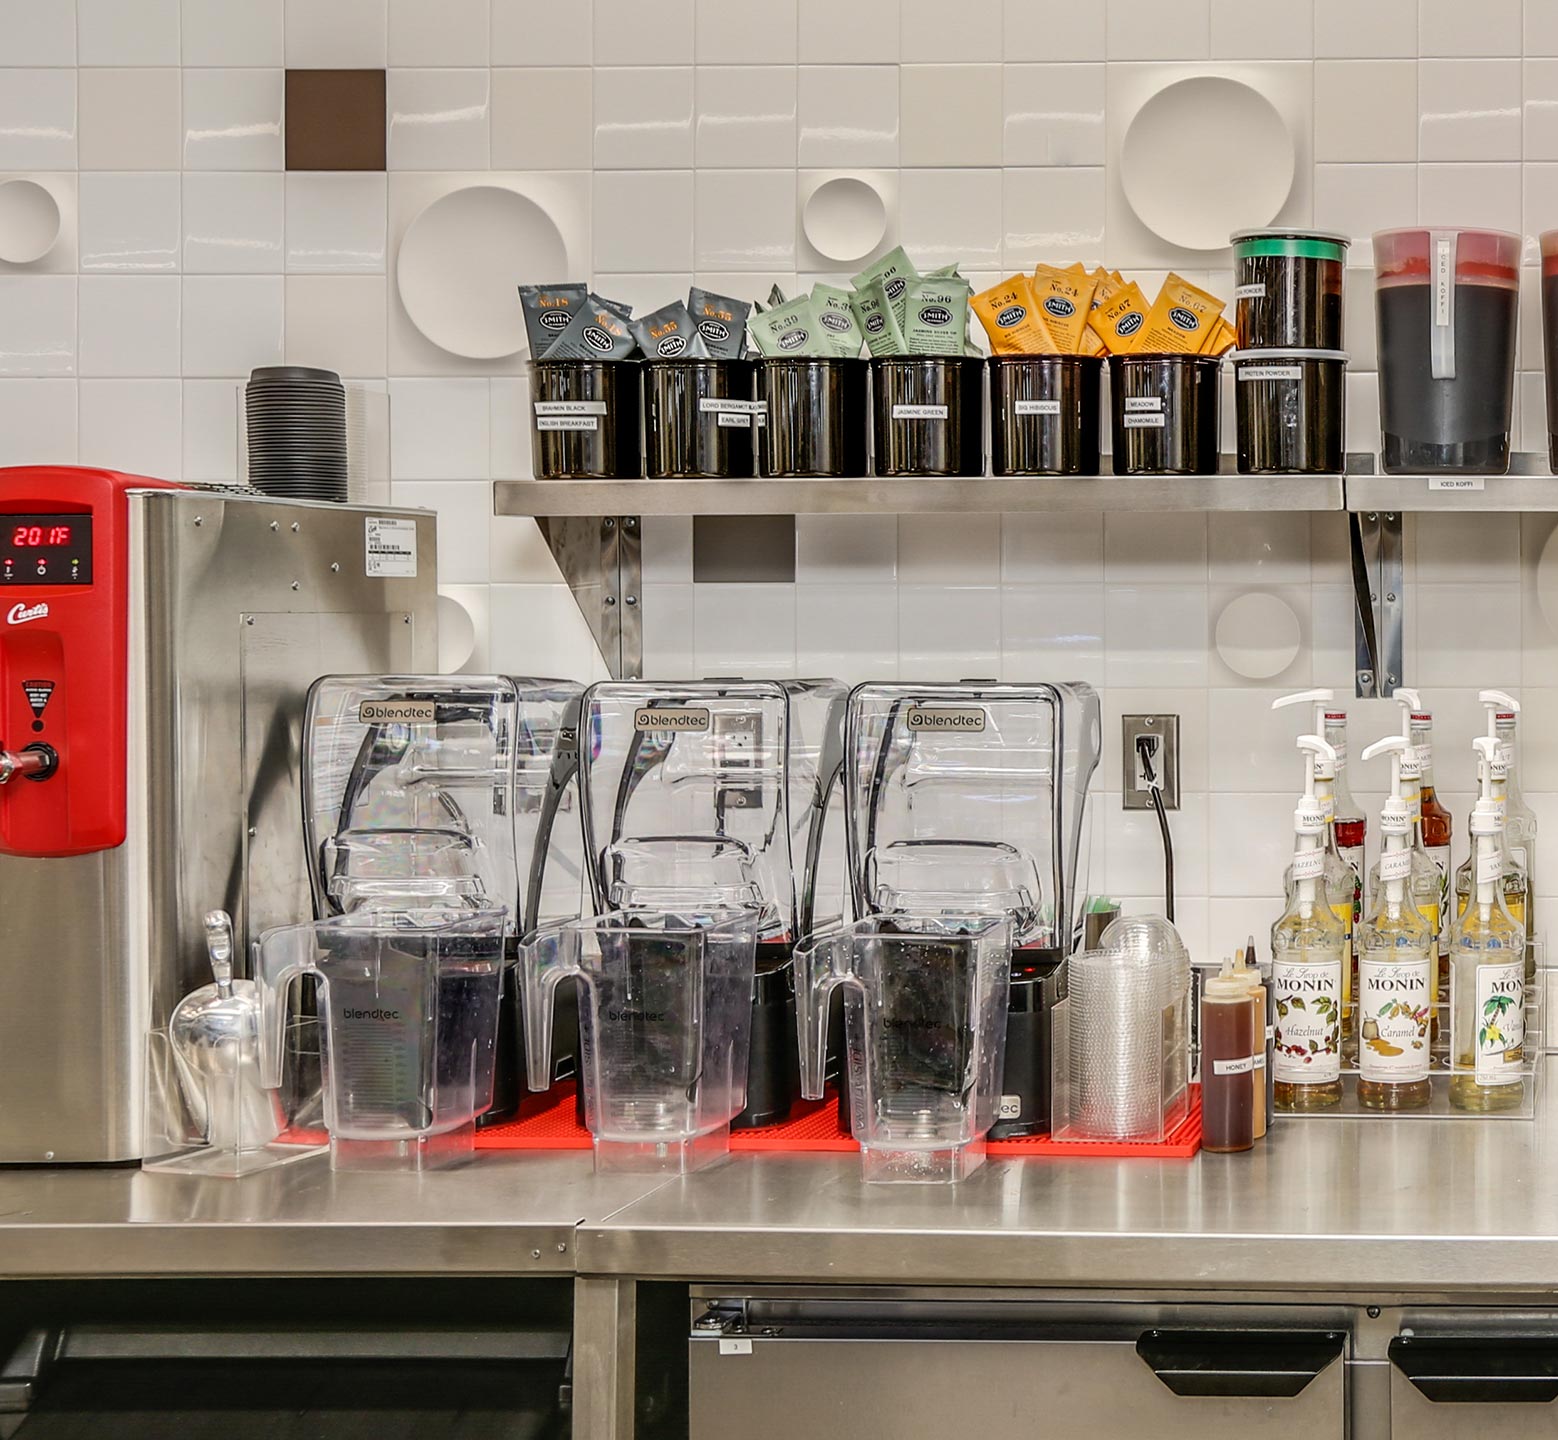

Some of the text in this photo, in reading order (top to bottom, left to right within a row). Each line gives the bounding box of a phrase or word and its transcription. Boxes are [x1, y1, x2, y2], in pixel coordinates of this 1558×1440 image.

[921, 294, 952, 304] No.96
[6, 602, 49, 625] Curtis
[376, 707, 433, 720] blendtec
[650, 713, 707, 728] blendtec
[923, 714, 982, 728] blendtec
[1283, 967, 1329, 981] Le Sirop de
[1374, 967, 1421, 981] Le Sirop de
[1277, 978, 1335, 992] MONIN
[1367, 977, 1425, 992] MONIN
[1491, 979, 1523, 994] MON
[343, 1008, 399, 1021] blendtec
[1285, 1024, 1324, 1036] Hazelnut
[1380, 1025, 1416, 1038] Caramel
[1225, 1063, 1247, 1072] HONEY
